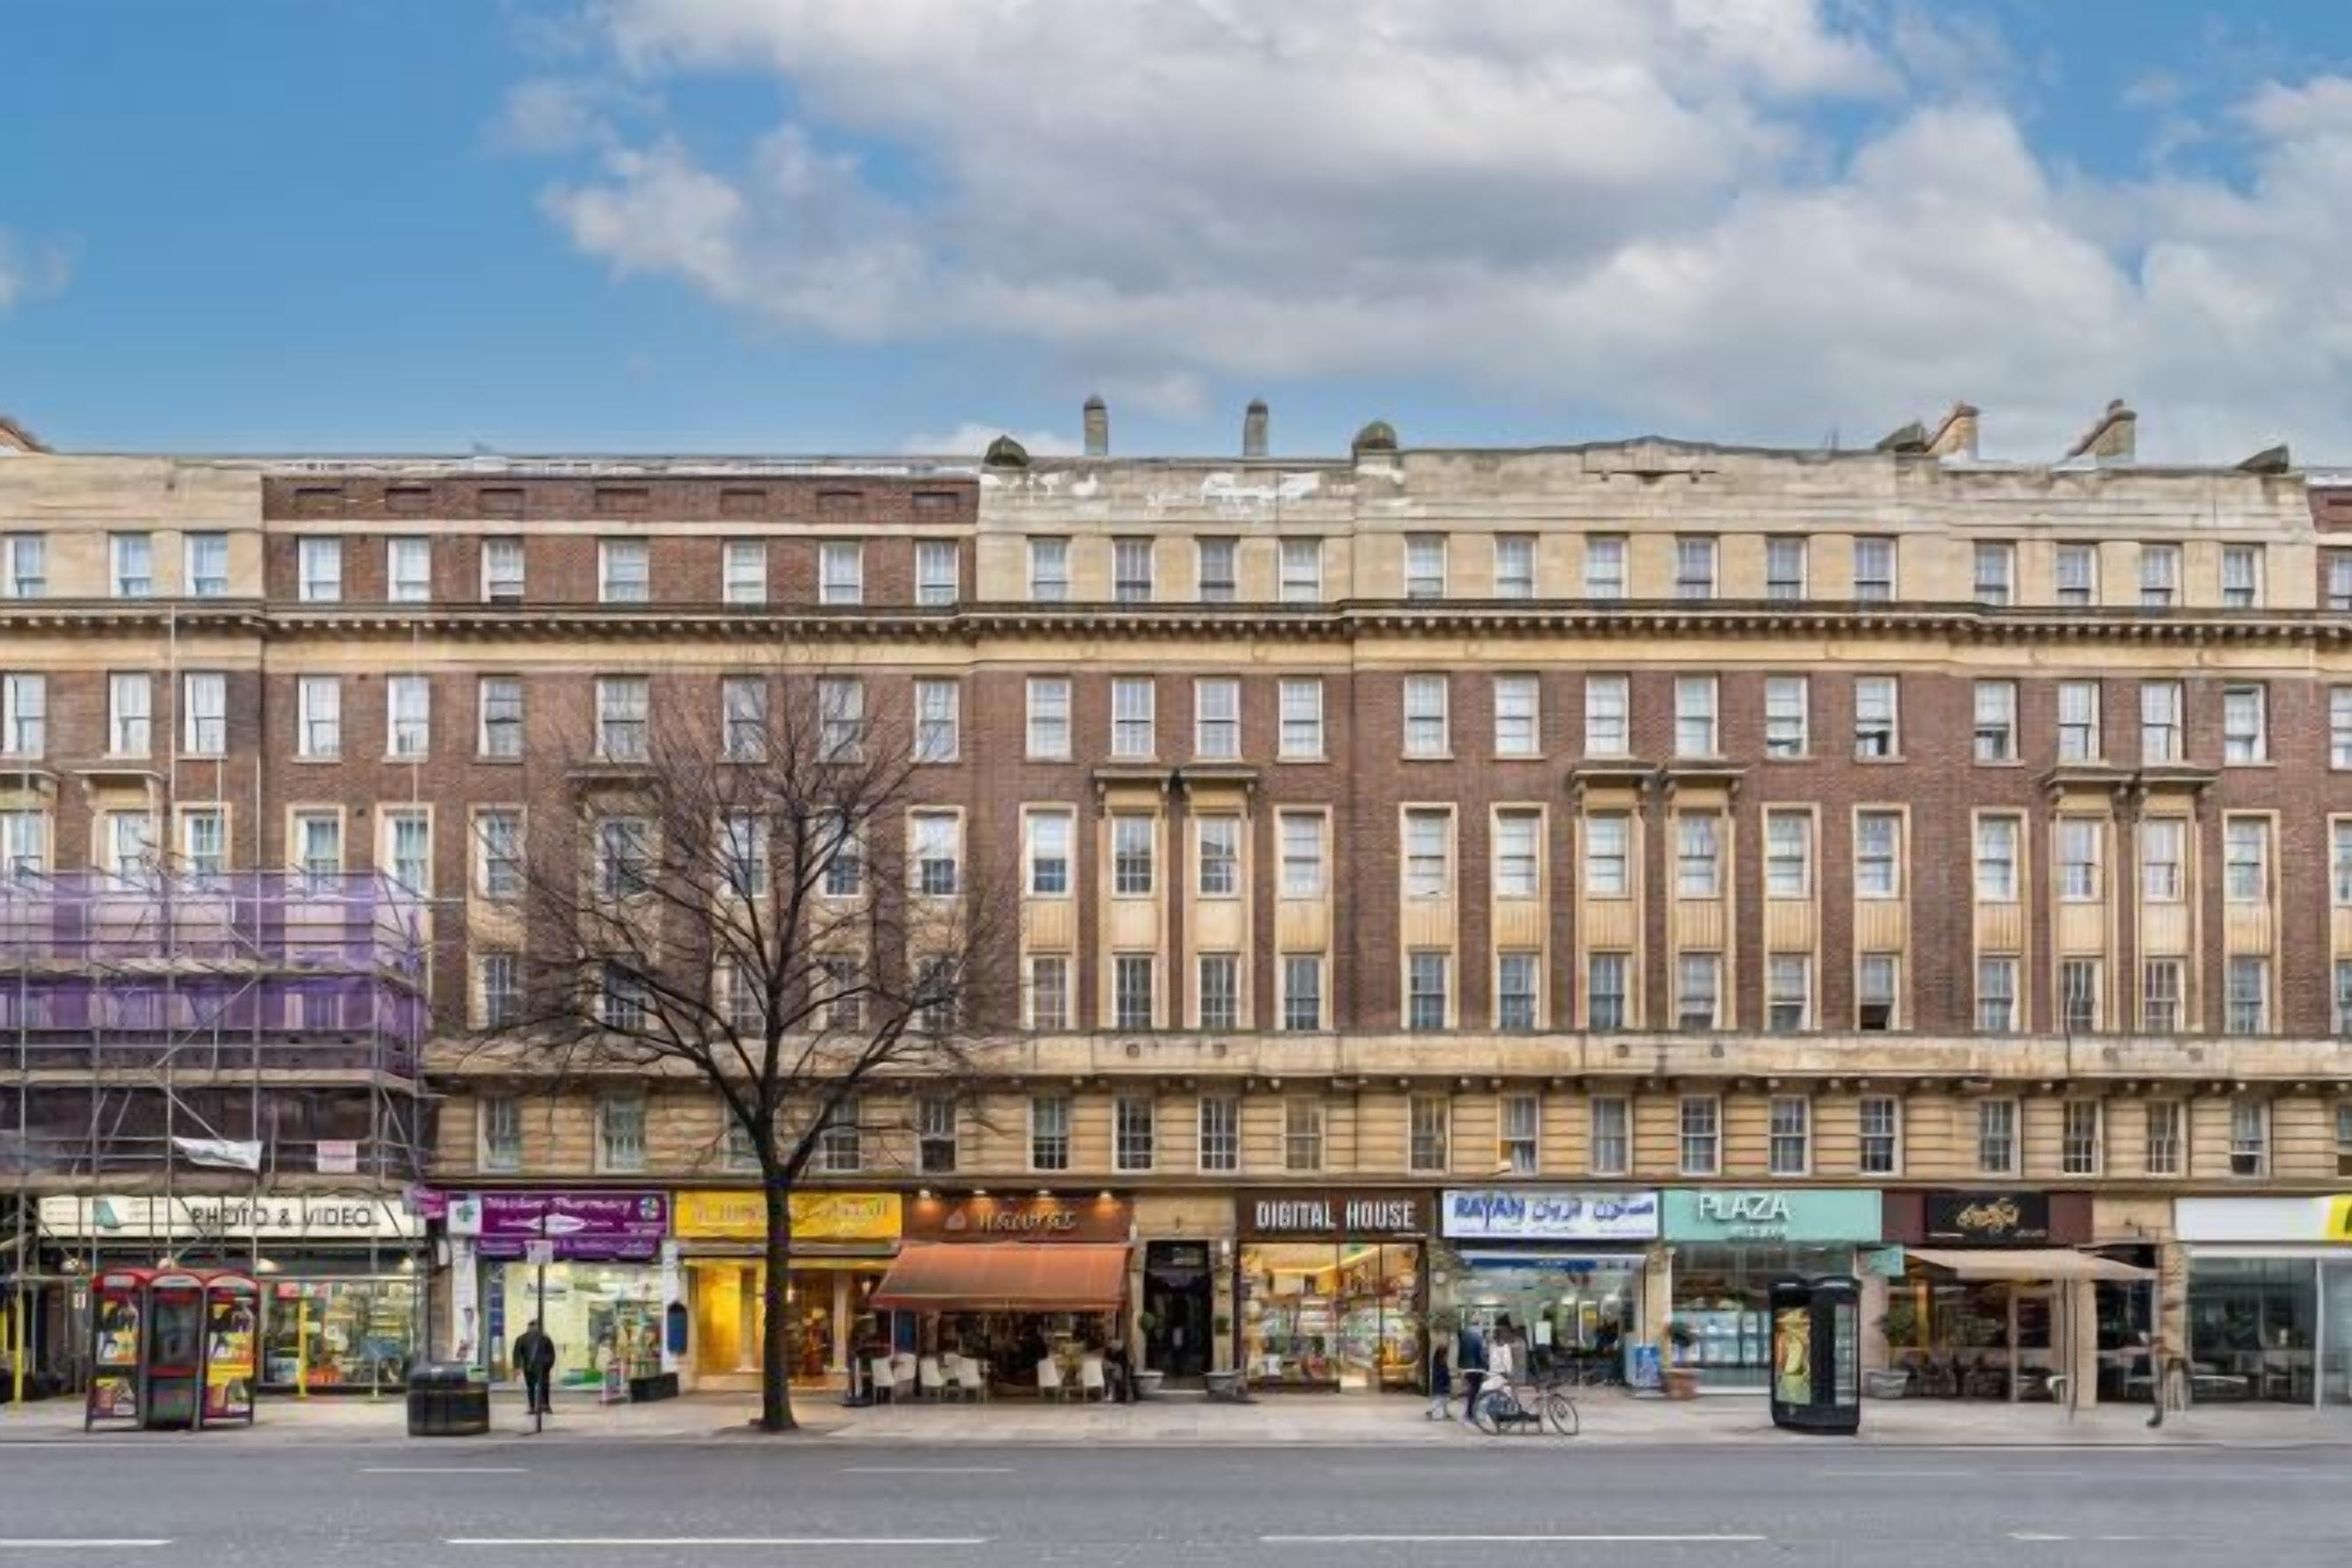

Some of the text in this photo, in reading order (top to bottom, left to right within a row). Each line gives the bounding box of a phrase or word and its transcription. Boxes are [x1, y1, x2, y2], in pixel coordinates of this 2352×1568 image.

[192, 1207, 270, 1227] PHOTO
[278, 1208, 292, 1228] &
[304, 1207, 372, 1227] VIDEO
[1256, 1200, 1416, 1228] DIGITAL HOUSE
[1454, 1196, 1525, 1226] RAYAN
[1700, 1193, 1792, 1221] PLAZA
